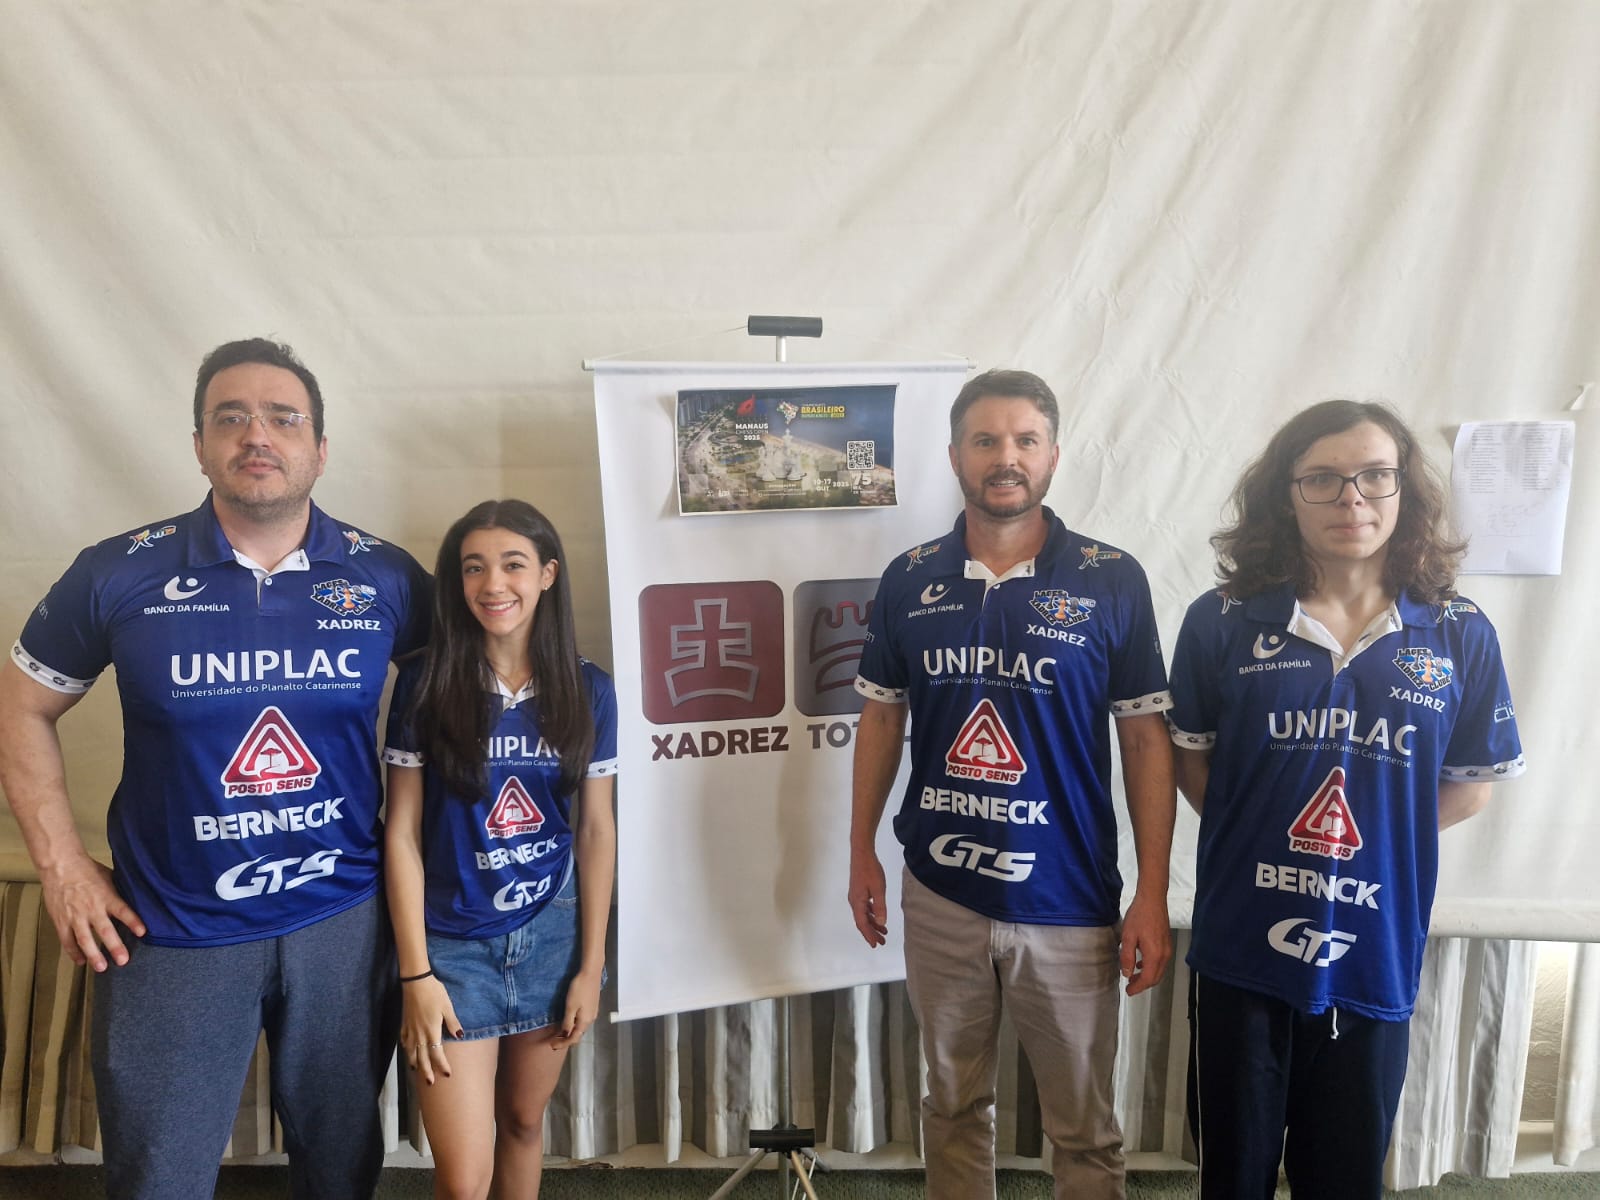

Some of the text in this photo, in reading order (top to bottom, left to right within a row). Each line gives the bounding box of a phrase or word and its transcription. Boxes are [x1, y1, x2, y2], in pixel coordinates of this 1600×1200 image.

[143, 603, 230, 615] BANCO DA FAMÍLIA
[927, 606, 937, 614] DA
[316, 619, 382, 631] XADREZ
[1025, 623, 1087, 647] XADREZ
[171, 648, 362, 686] UNIPLAC
[923, 646, 1057, 686] UNIPLAC
[1238, 658, 1312, 675] BANCO DA FAMÍLIA
[171, 680, 362, 699] Universidade do Planalto Catarinense
[1387, 685, 1446, 713] XADREZ
[651, 725, 790, 762] XADREZ
[1268, 707, 1418, 757] UNIPLAC
[1320, 741, 1331, 750] do
[1361, 750, 1412, 768] Catarinense
[228, 777, 313, 796] POSTO SENS
[946, 764, 1018, 783] POSTO SENS
[920, 785, 1050, 825] BERNECK
[192, 797, 345, 841] BERNECK
[515, 824, 539, 833] SENS
[474, 834, 559, 870] BERNECK
[928, 833, 1037, 883] GTS
[1292, 839, 1331, 854] POSTO
[215, 848, 343, 901] GTS
[1255, 862, 1382, 910] BERNCK
